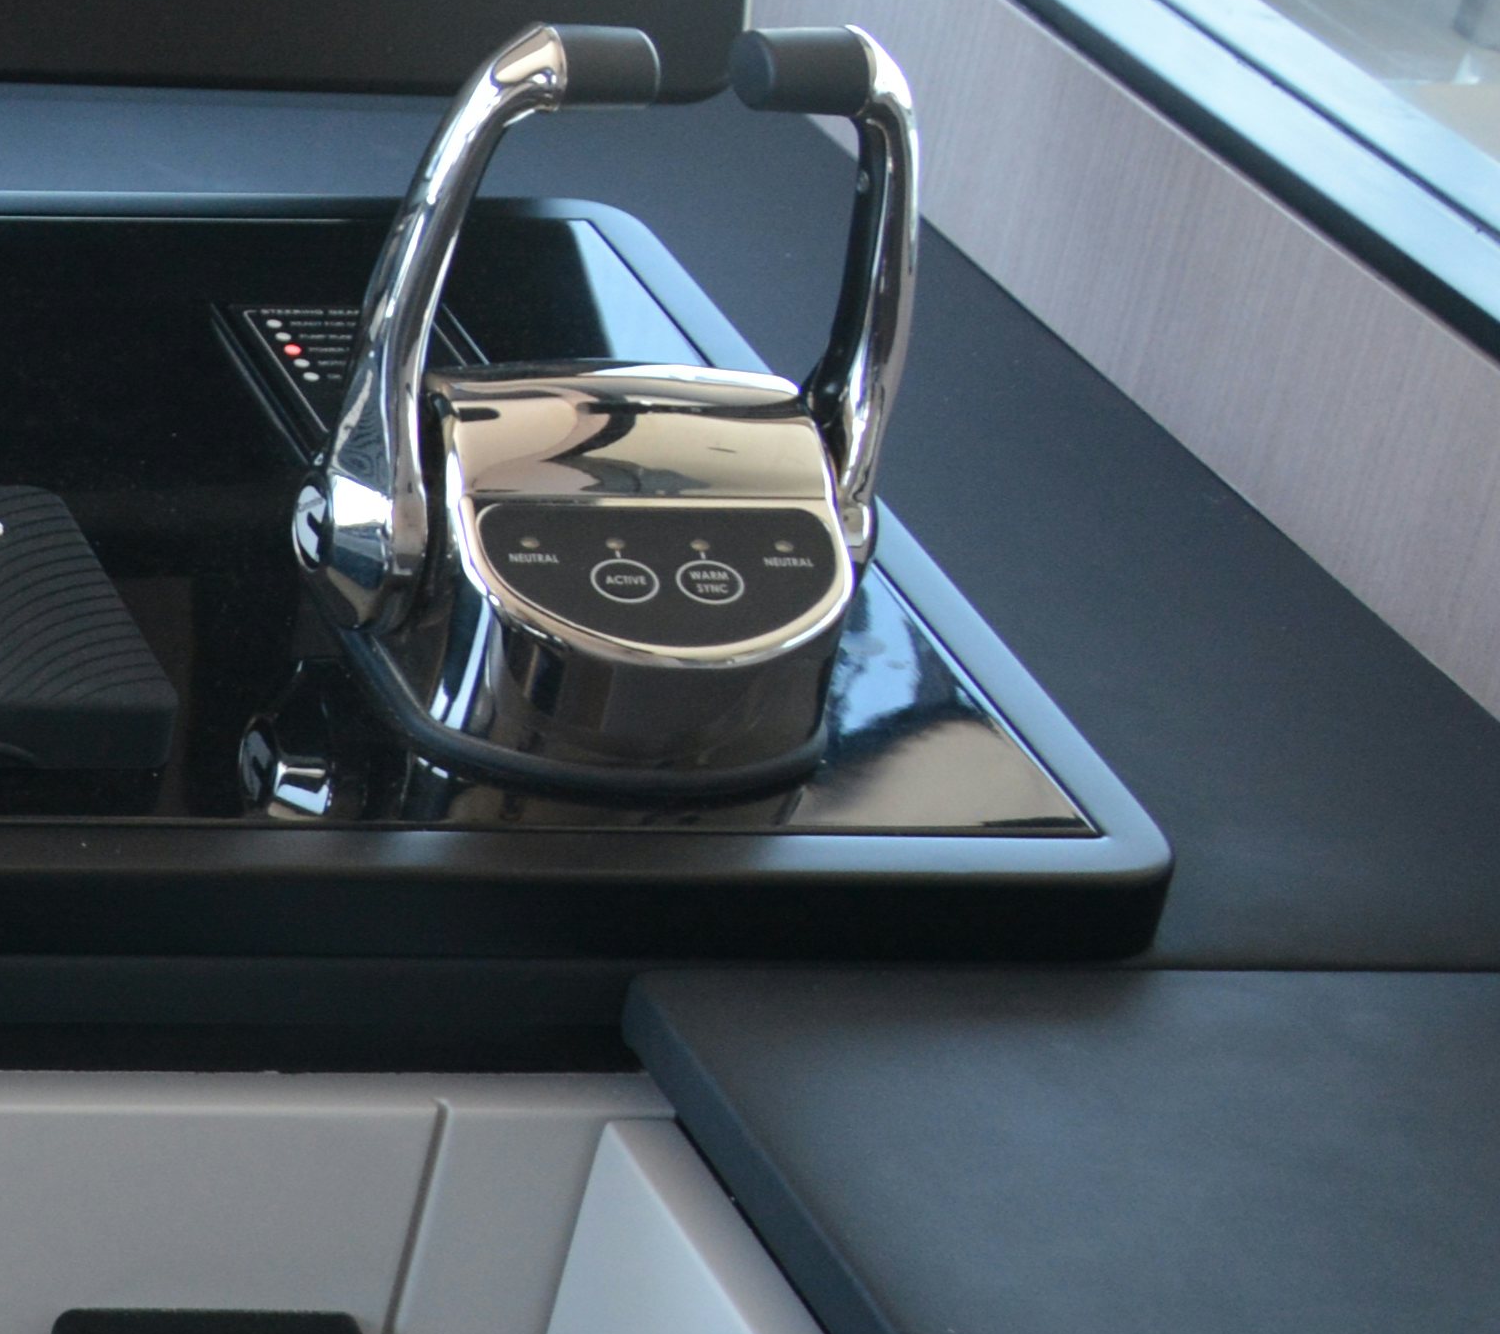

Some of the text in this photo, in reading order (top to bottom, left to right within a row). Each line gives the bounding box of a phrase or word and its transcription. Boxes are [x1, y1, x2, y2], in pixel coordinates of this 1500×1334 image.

[509, 553, 560, 564] NEUTRAL
[764, 556, 814, 568] NEUTRAL
[606, 575, 648, 586] ACTIVE
[689, 570, 730, 581] WARM
[697, 583, 730, 594] SYNC
